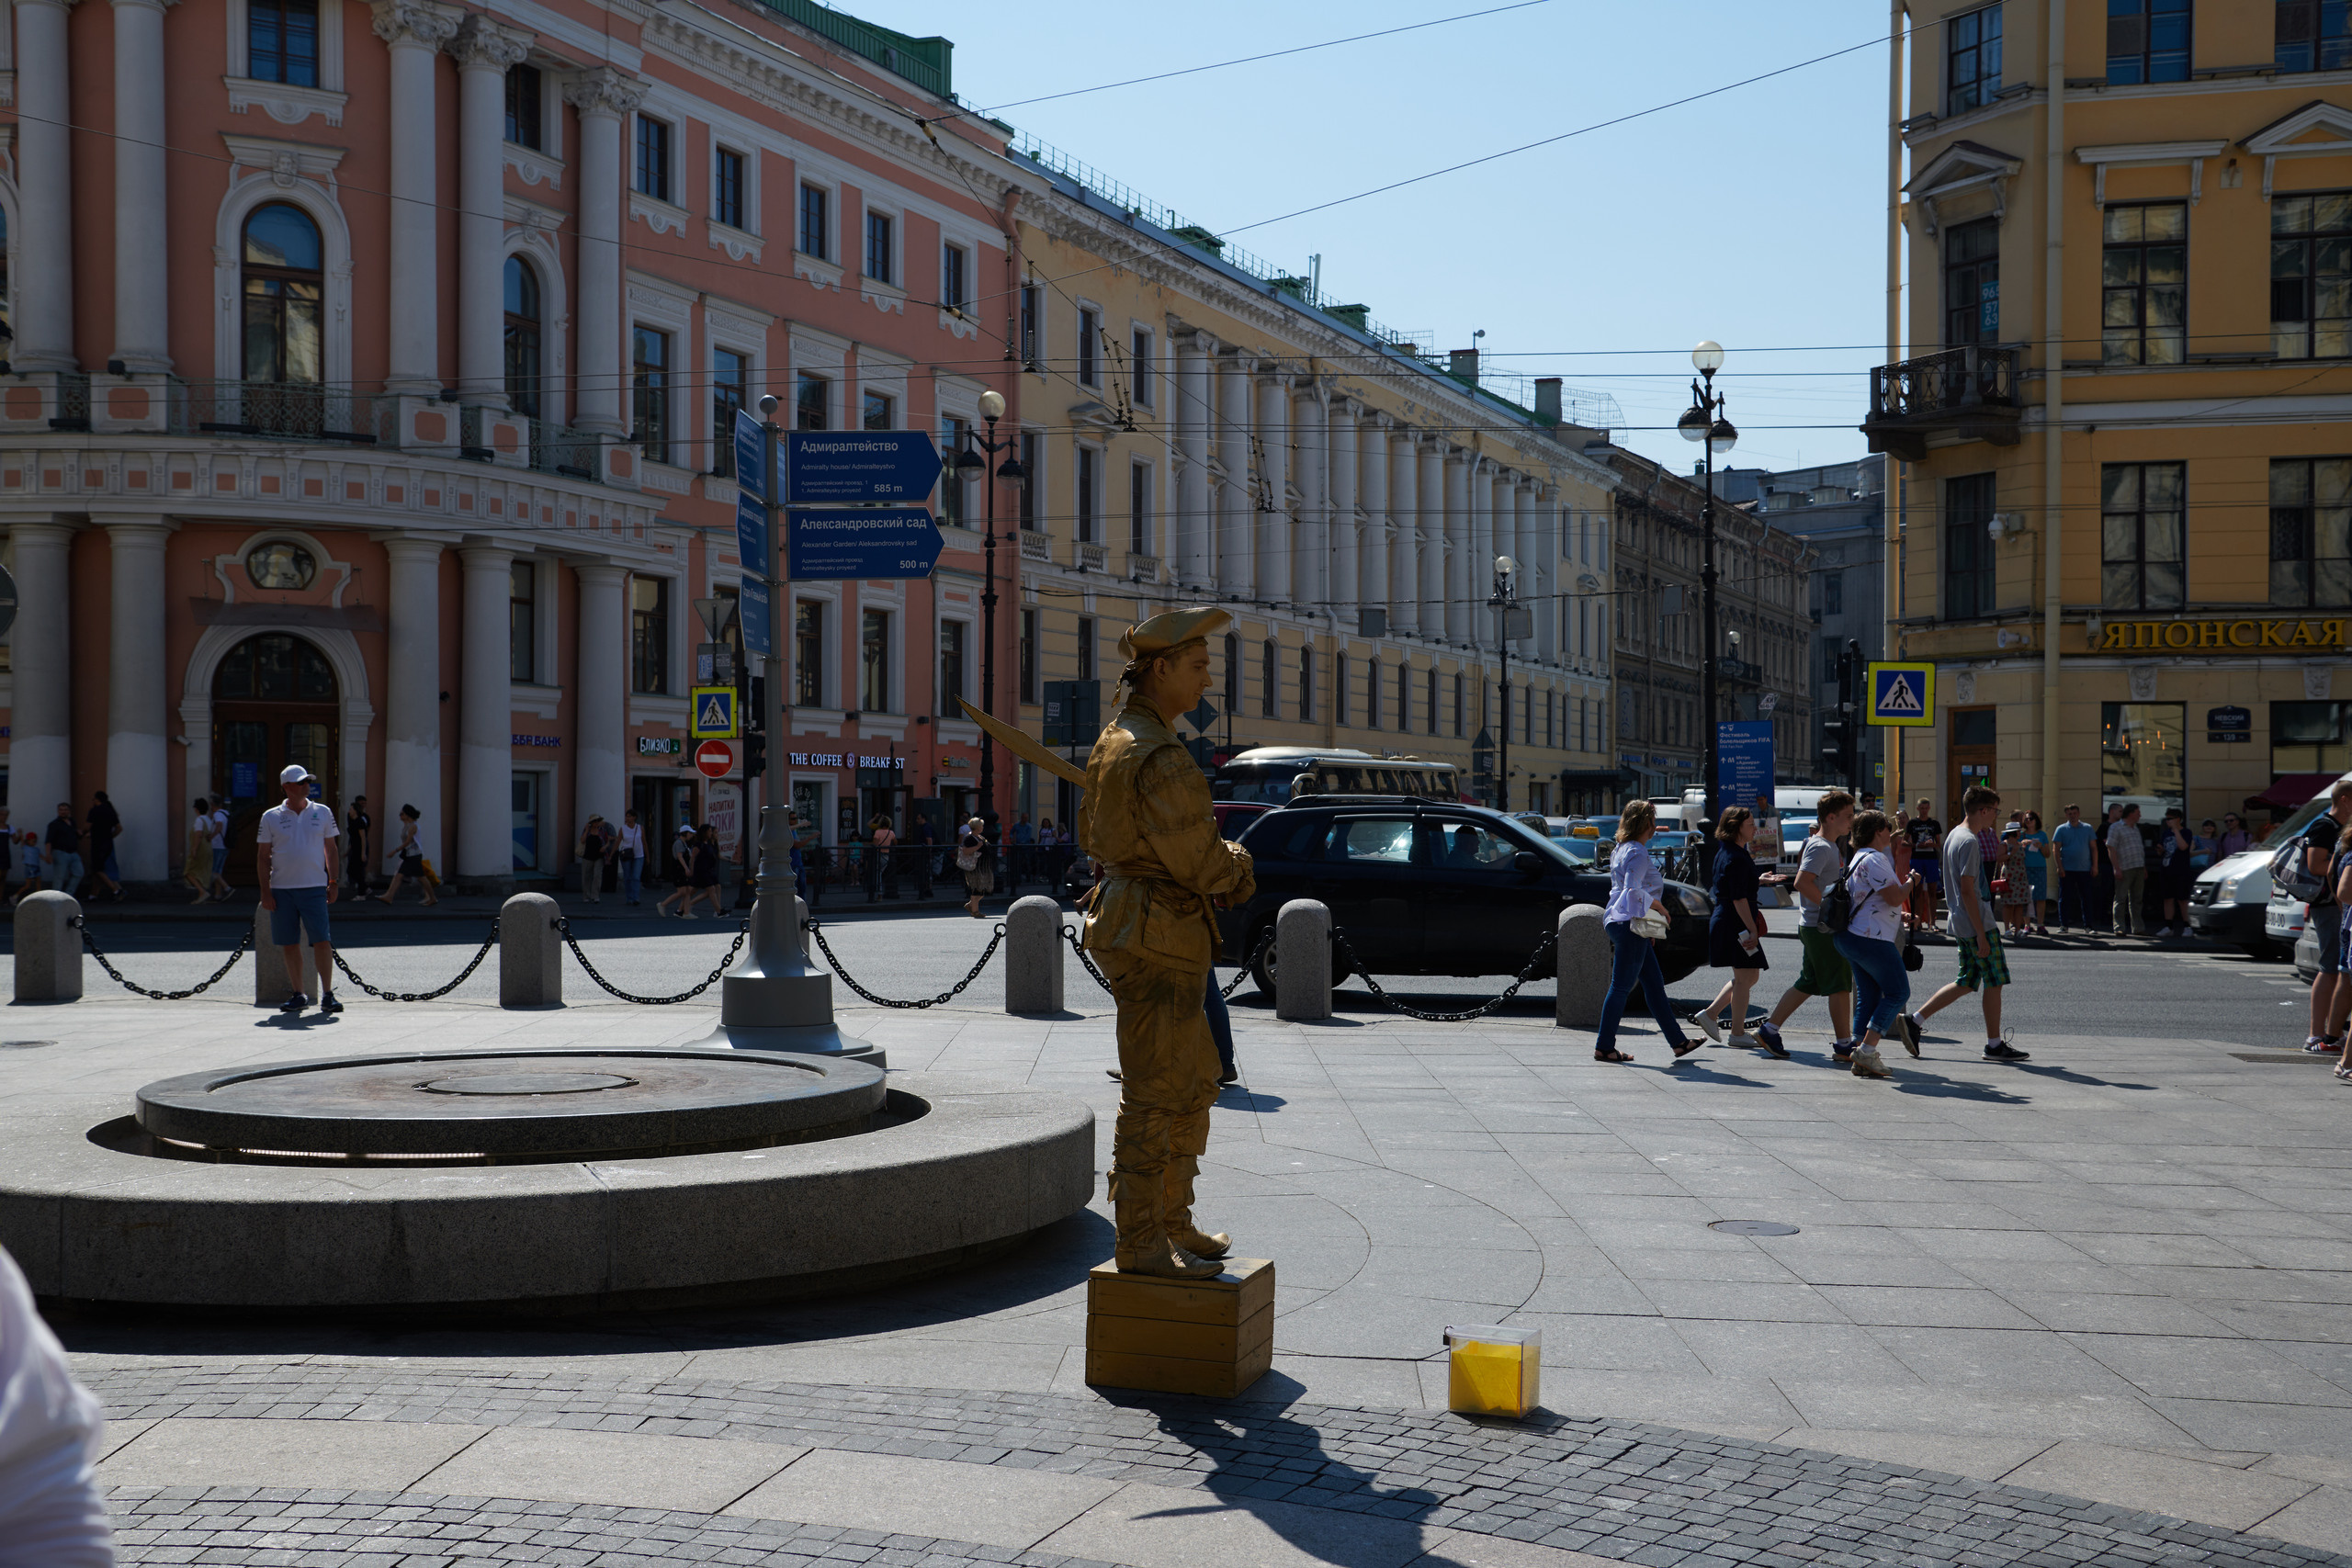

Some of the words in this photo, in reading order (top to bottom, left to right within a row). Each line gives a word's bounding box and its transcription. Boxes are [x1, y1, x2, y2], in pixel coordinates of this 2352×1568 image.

[800, 440, 899, 454] Адмиралтейство
[874, 484, 891, 493] 585
[800, 517, 903, 531] Александровский
[906, 518, 927, 529] сад
[899, 560, 916, 569] 500
[2101, 619, 2346, 649] ЯПОНСКАЯ
[535, 735, 561, 747] БАНК
[640, 737, 670, 753] БЛИЗКО
[789, 752, 808, 765] THE
[810, 753, 842, 767] COFFEE
[859, 756, 905, 769] BREAKFST
[709, 799, 735, 813] НАПИТКИ
[709, 812, 735, 832] СОКИ
